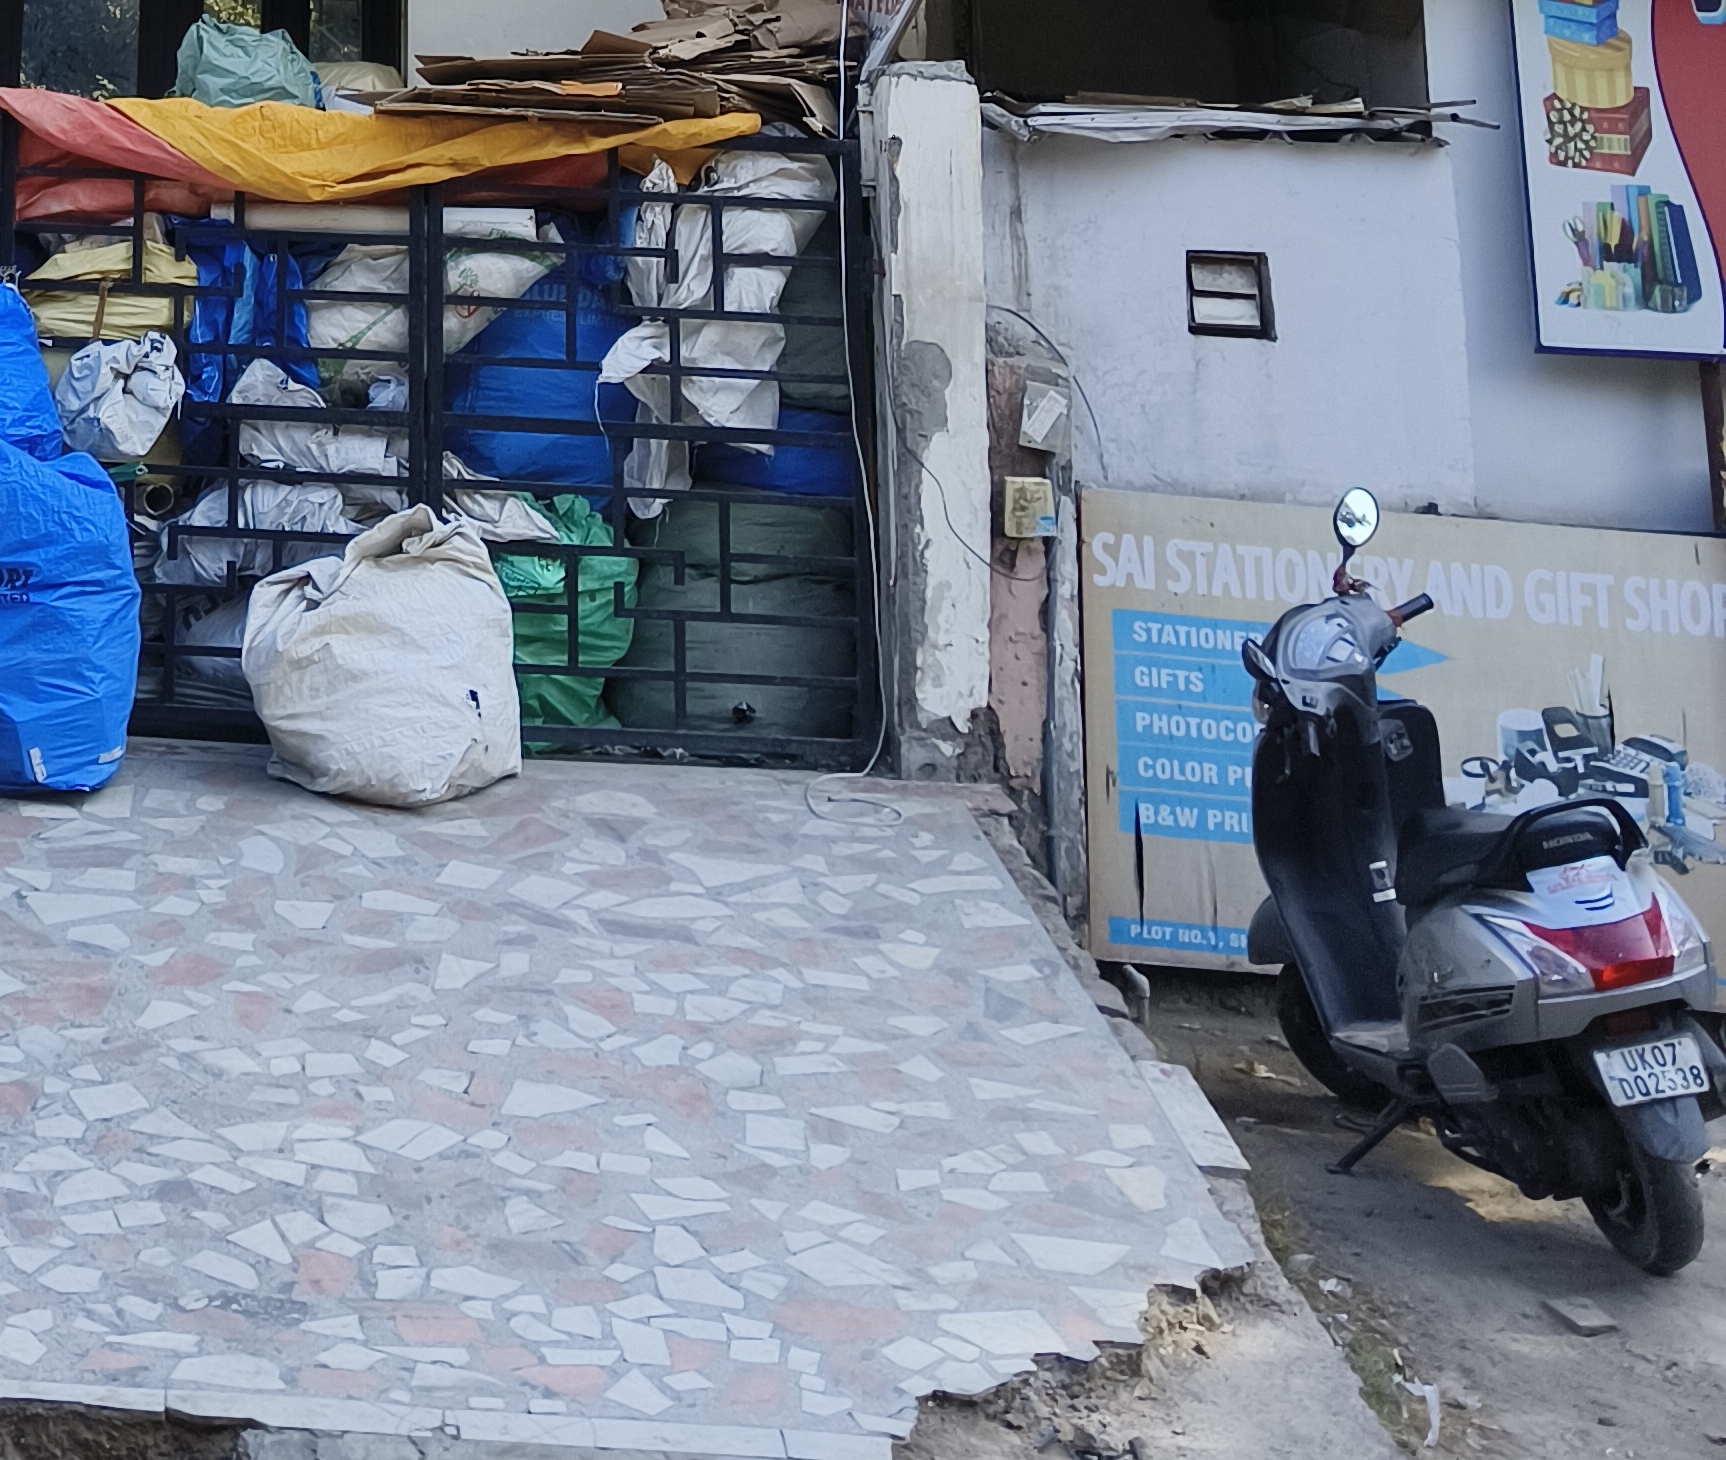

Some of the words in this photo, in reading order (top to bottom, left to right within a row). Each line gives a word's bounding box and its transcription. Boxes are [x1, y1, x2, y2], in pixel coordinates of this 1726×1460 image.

[1091, 530, 1156, 588] SAI
[1426, 559, 1514, 621] AND
[1524, 568, 1615, 627] GIFT
[1134, 665, 1204, 692] GIFTS
[1137, 756, 1219, 785] COLOR
[1138, 802, 1199, 829] B&W
[1130, 923, 1173, 941] PLOT
[1620, 1042, 1677, 1073] UK07
